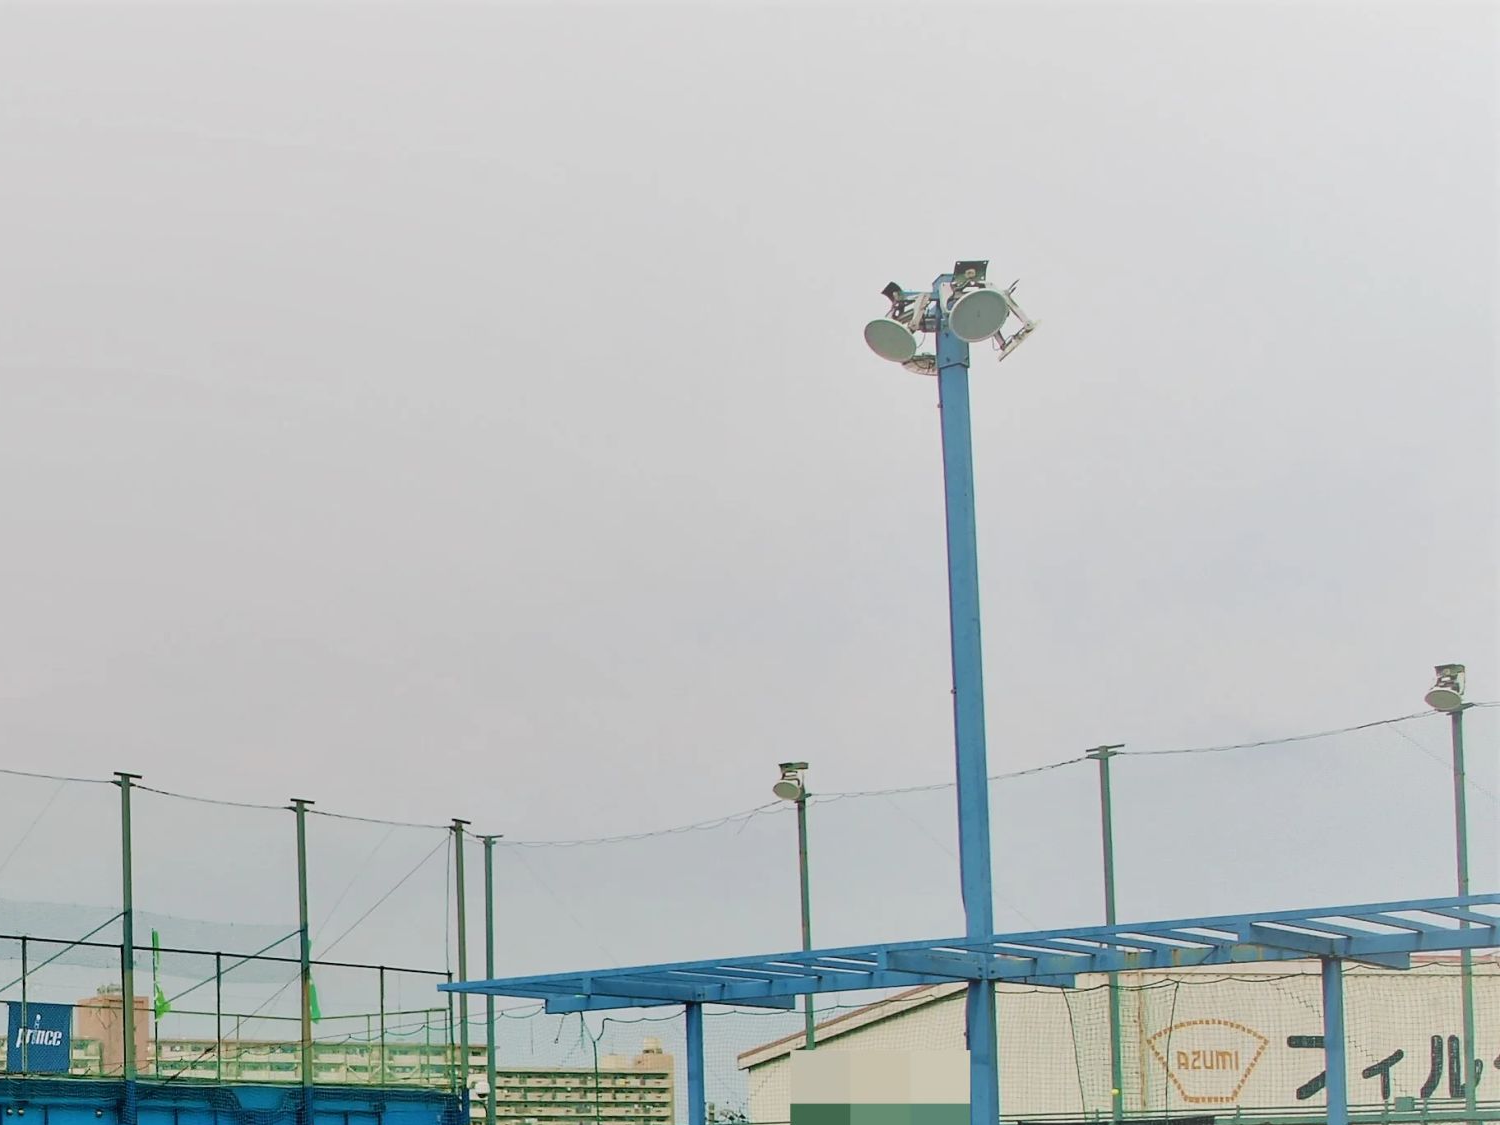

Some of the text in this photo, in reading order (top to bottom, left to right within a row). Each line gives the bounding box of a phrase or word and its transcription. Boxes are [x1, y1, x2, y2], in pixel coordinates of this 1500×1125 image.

[16, 1014, 62, 1048] prince
[1177, 1050, 1239, 1071] AZUMI
[1287, 1034, 1500, 1102] フィル
